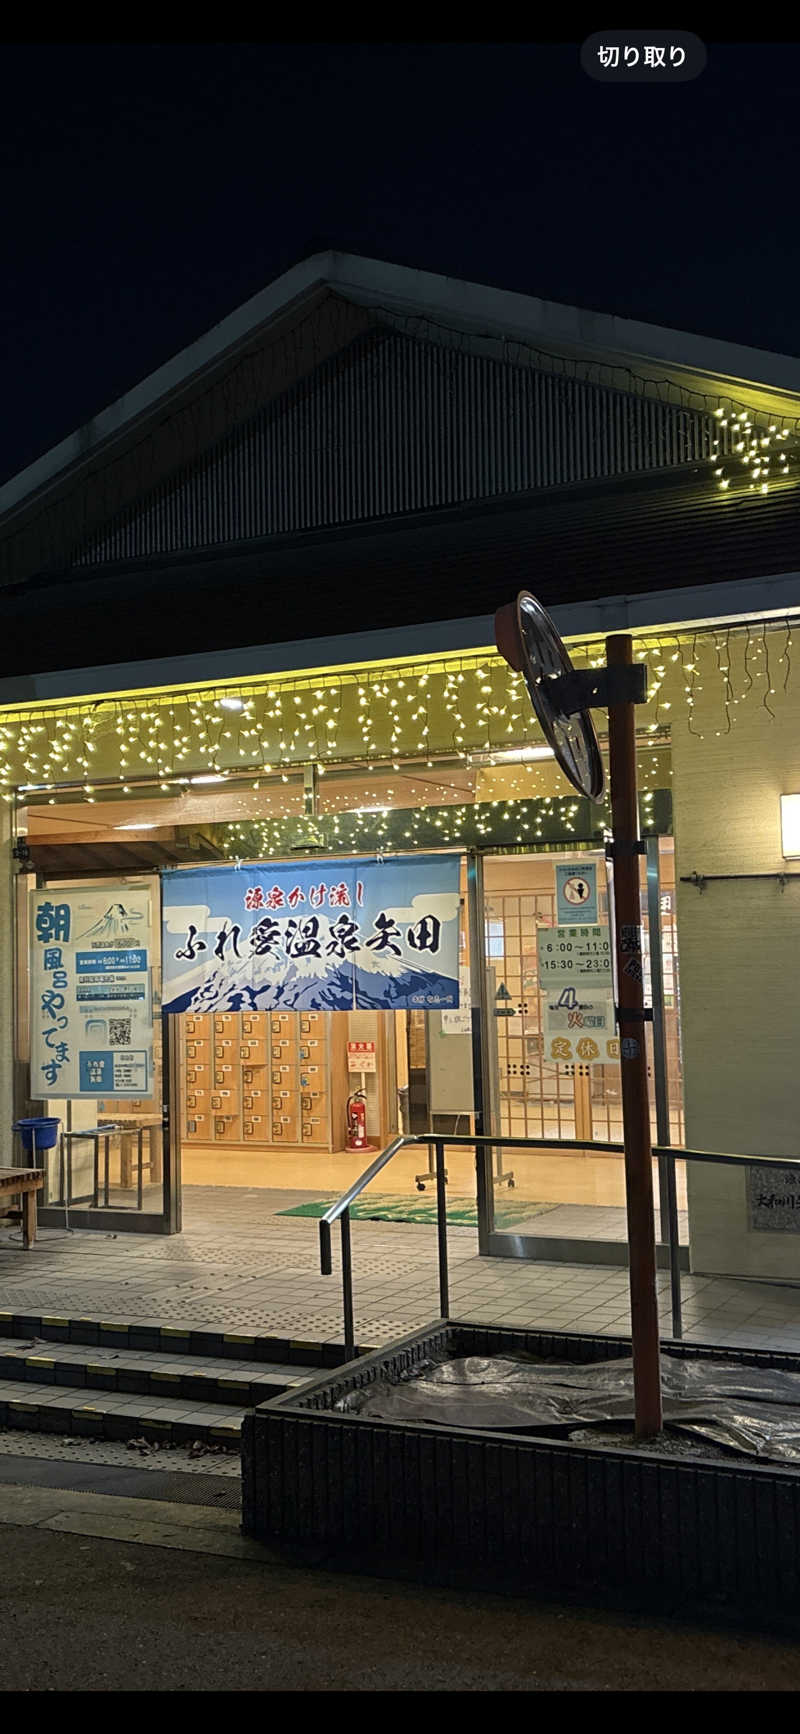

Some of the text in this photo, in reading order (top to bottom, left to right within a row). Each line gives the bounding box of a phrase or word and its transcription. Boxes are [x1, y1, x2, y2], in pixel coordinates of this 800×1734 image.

[245, 882, 364, 910] 源泉かけ流し
[176, 913, 441, 961] ふれ愛温泉矢田
[552, 1038, 620, 1059] 定休日
